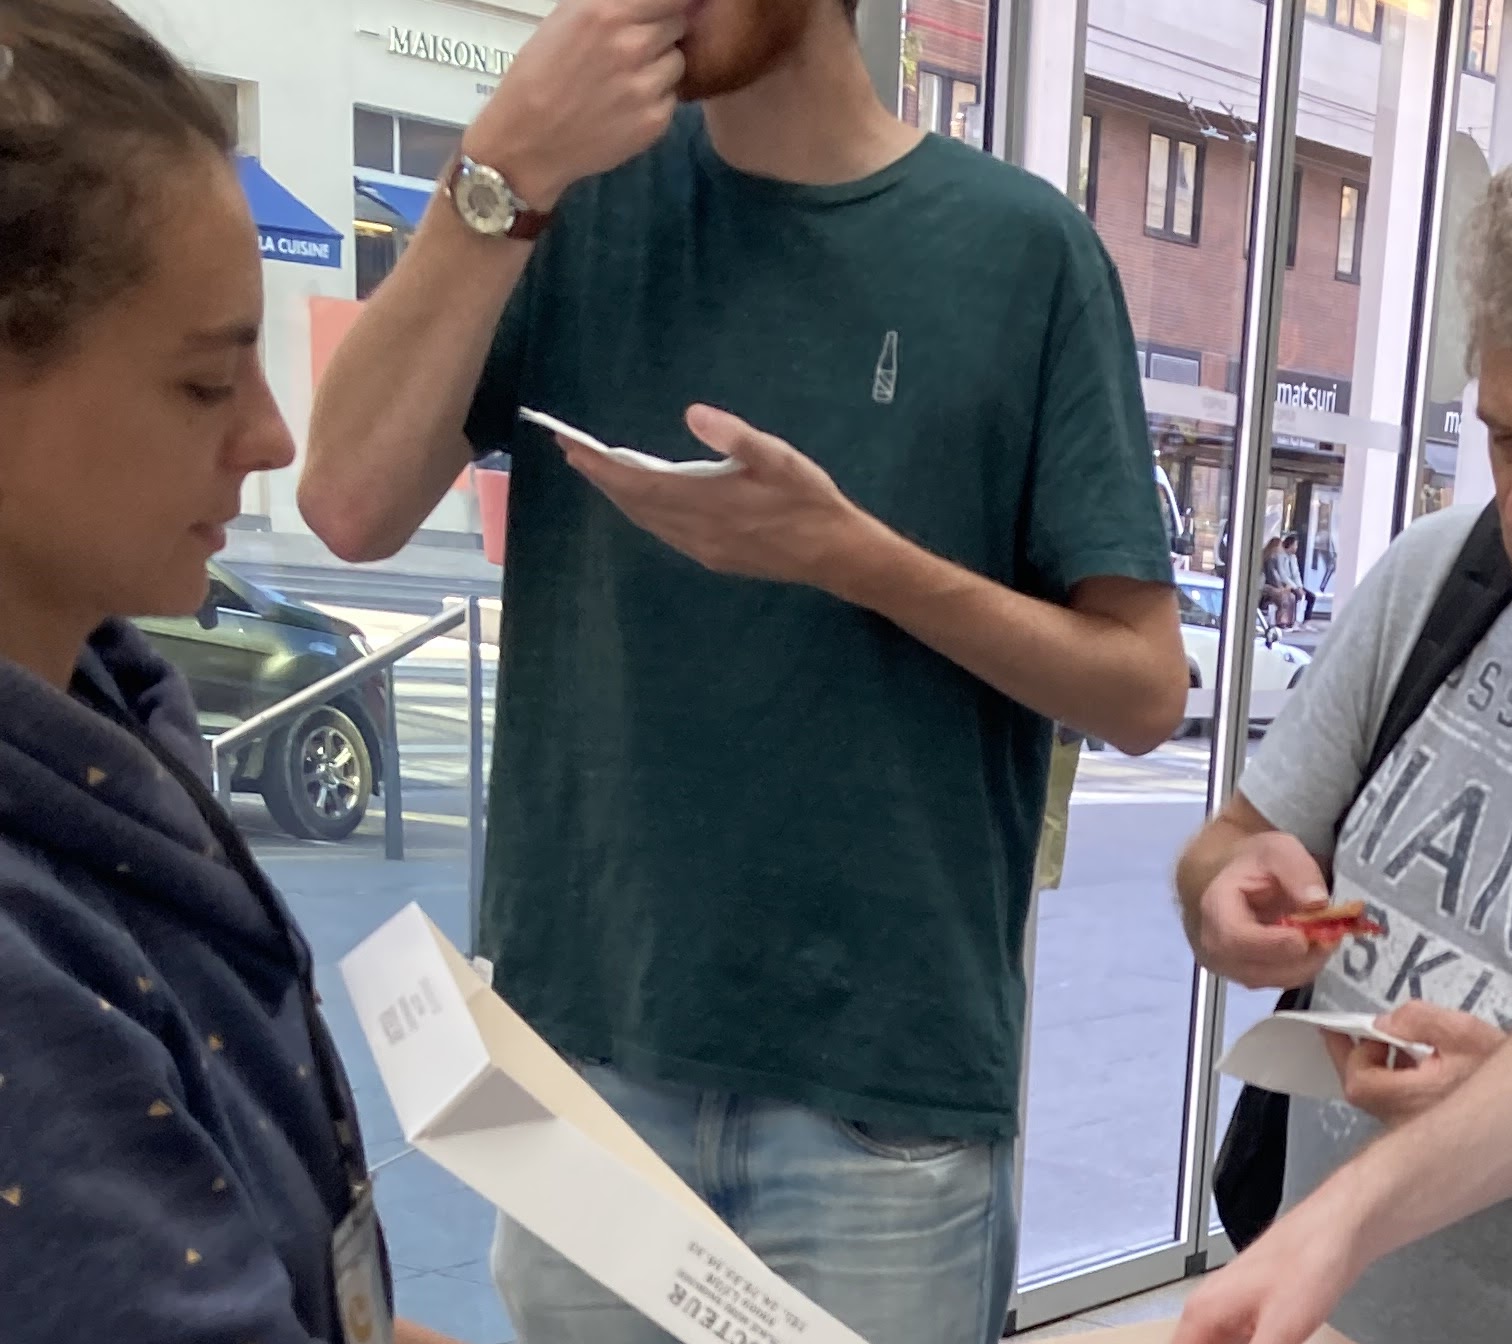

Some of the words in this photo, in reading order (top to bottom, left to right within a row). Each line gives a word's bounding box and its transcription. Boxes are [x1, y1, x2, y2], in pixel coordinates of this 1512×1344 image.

[388, 25, 488, 72] MAISON
[277, 238, 329, 259] CUISINE
[1276, 381, 1338, 413] matsuri
